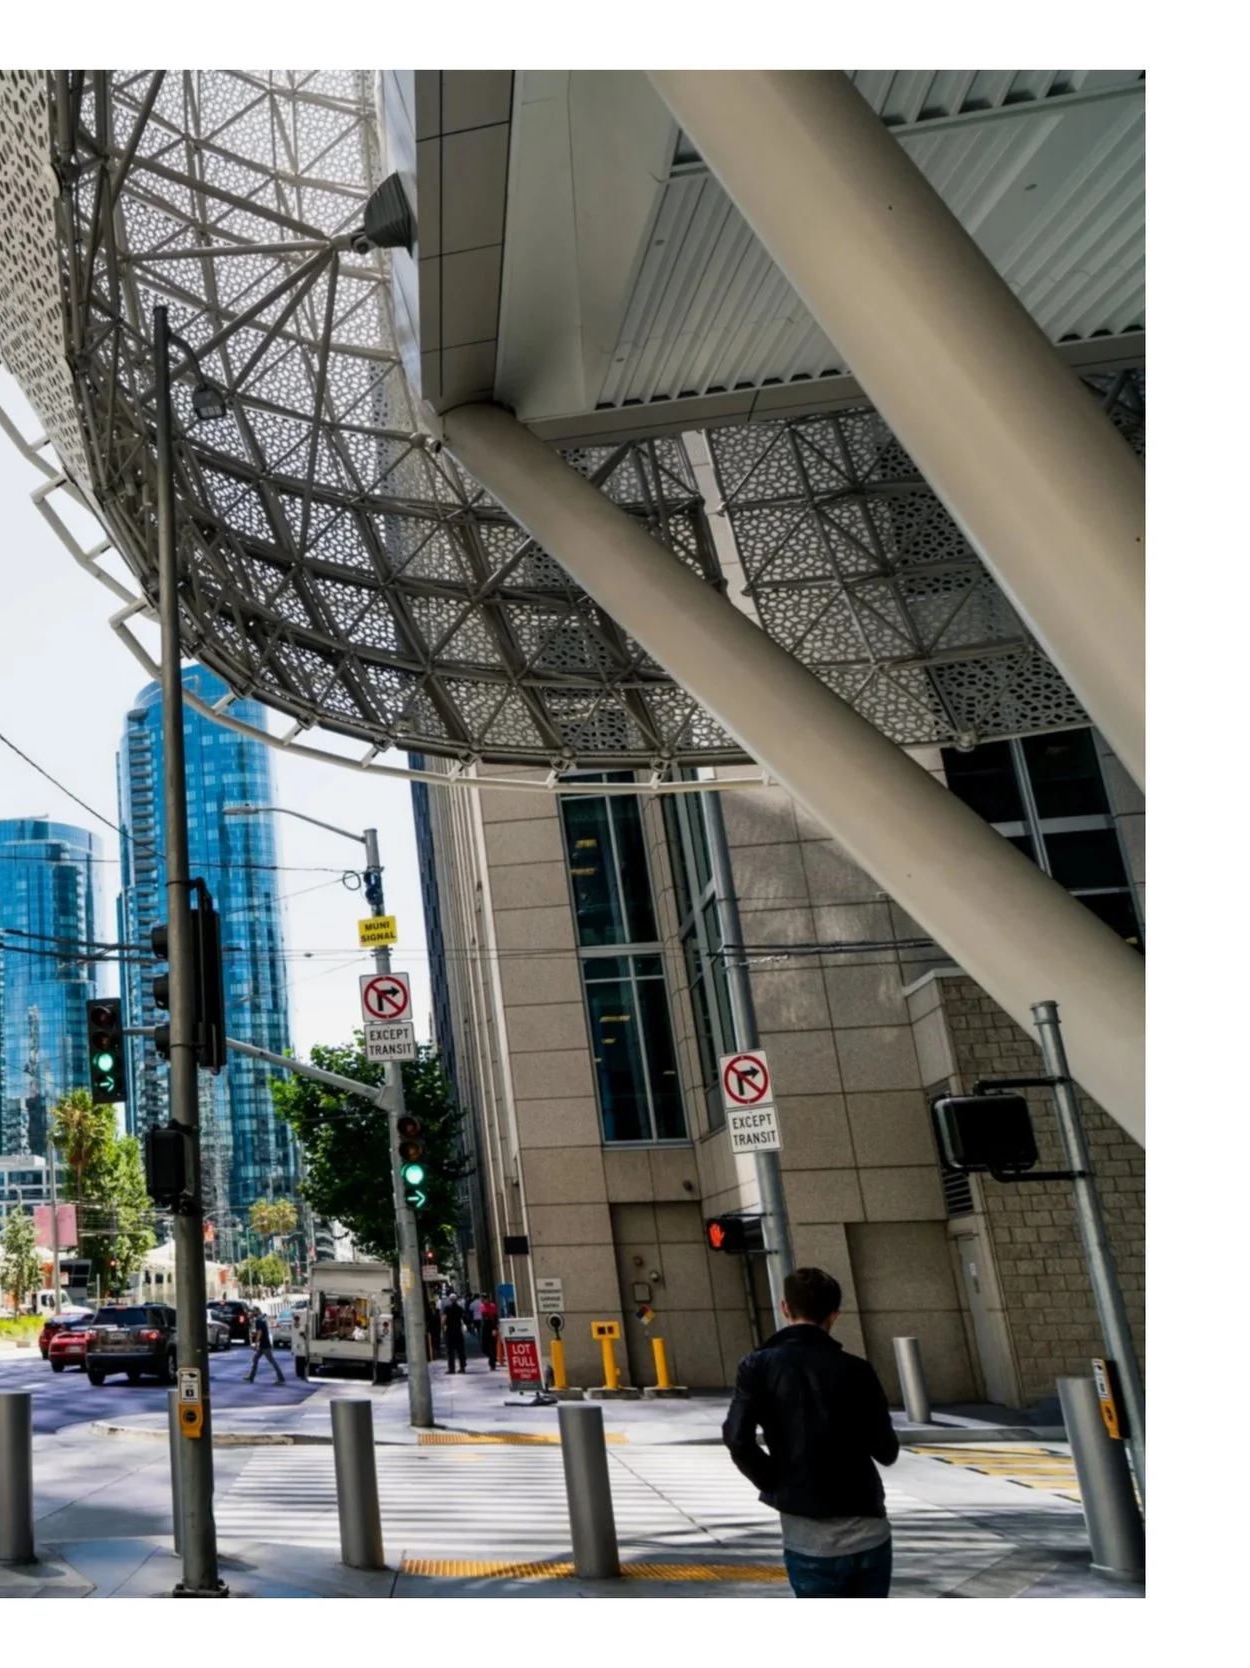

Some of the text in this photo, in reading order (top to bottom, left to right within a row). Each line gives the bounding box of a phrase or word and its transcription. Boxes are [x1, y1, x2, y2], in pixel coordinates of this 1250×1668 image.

[365, 920, 390, 931] MUNI
[360, 930, 396, 943] SIGNAL
[369, 1028, 409, 1041] EXCEPT
[368, 1042, 412, 1056] TRANSIT
[731, 1113, 772, 1130] EXCEPT
[732, 1130, 776, 1146] TRANSIT
[511, 1343, 530, 1355] LOT
[512, 1356, 535, 1367] FULL
